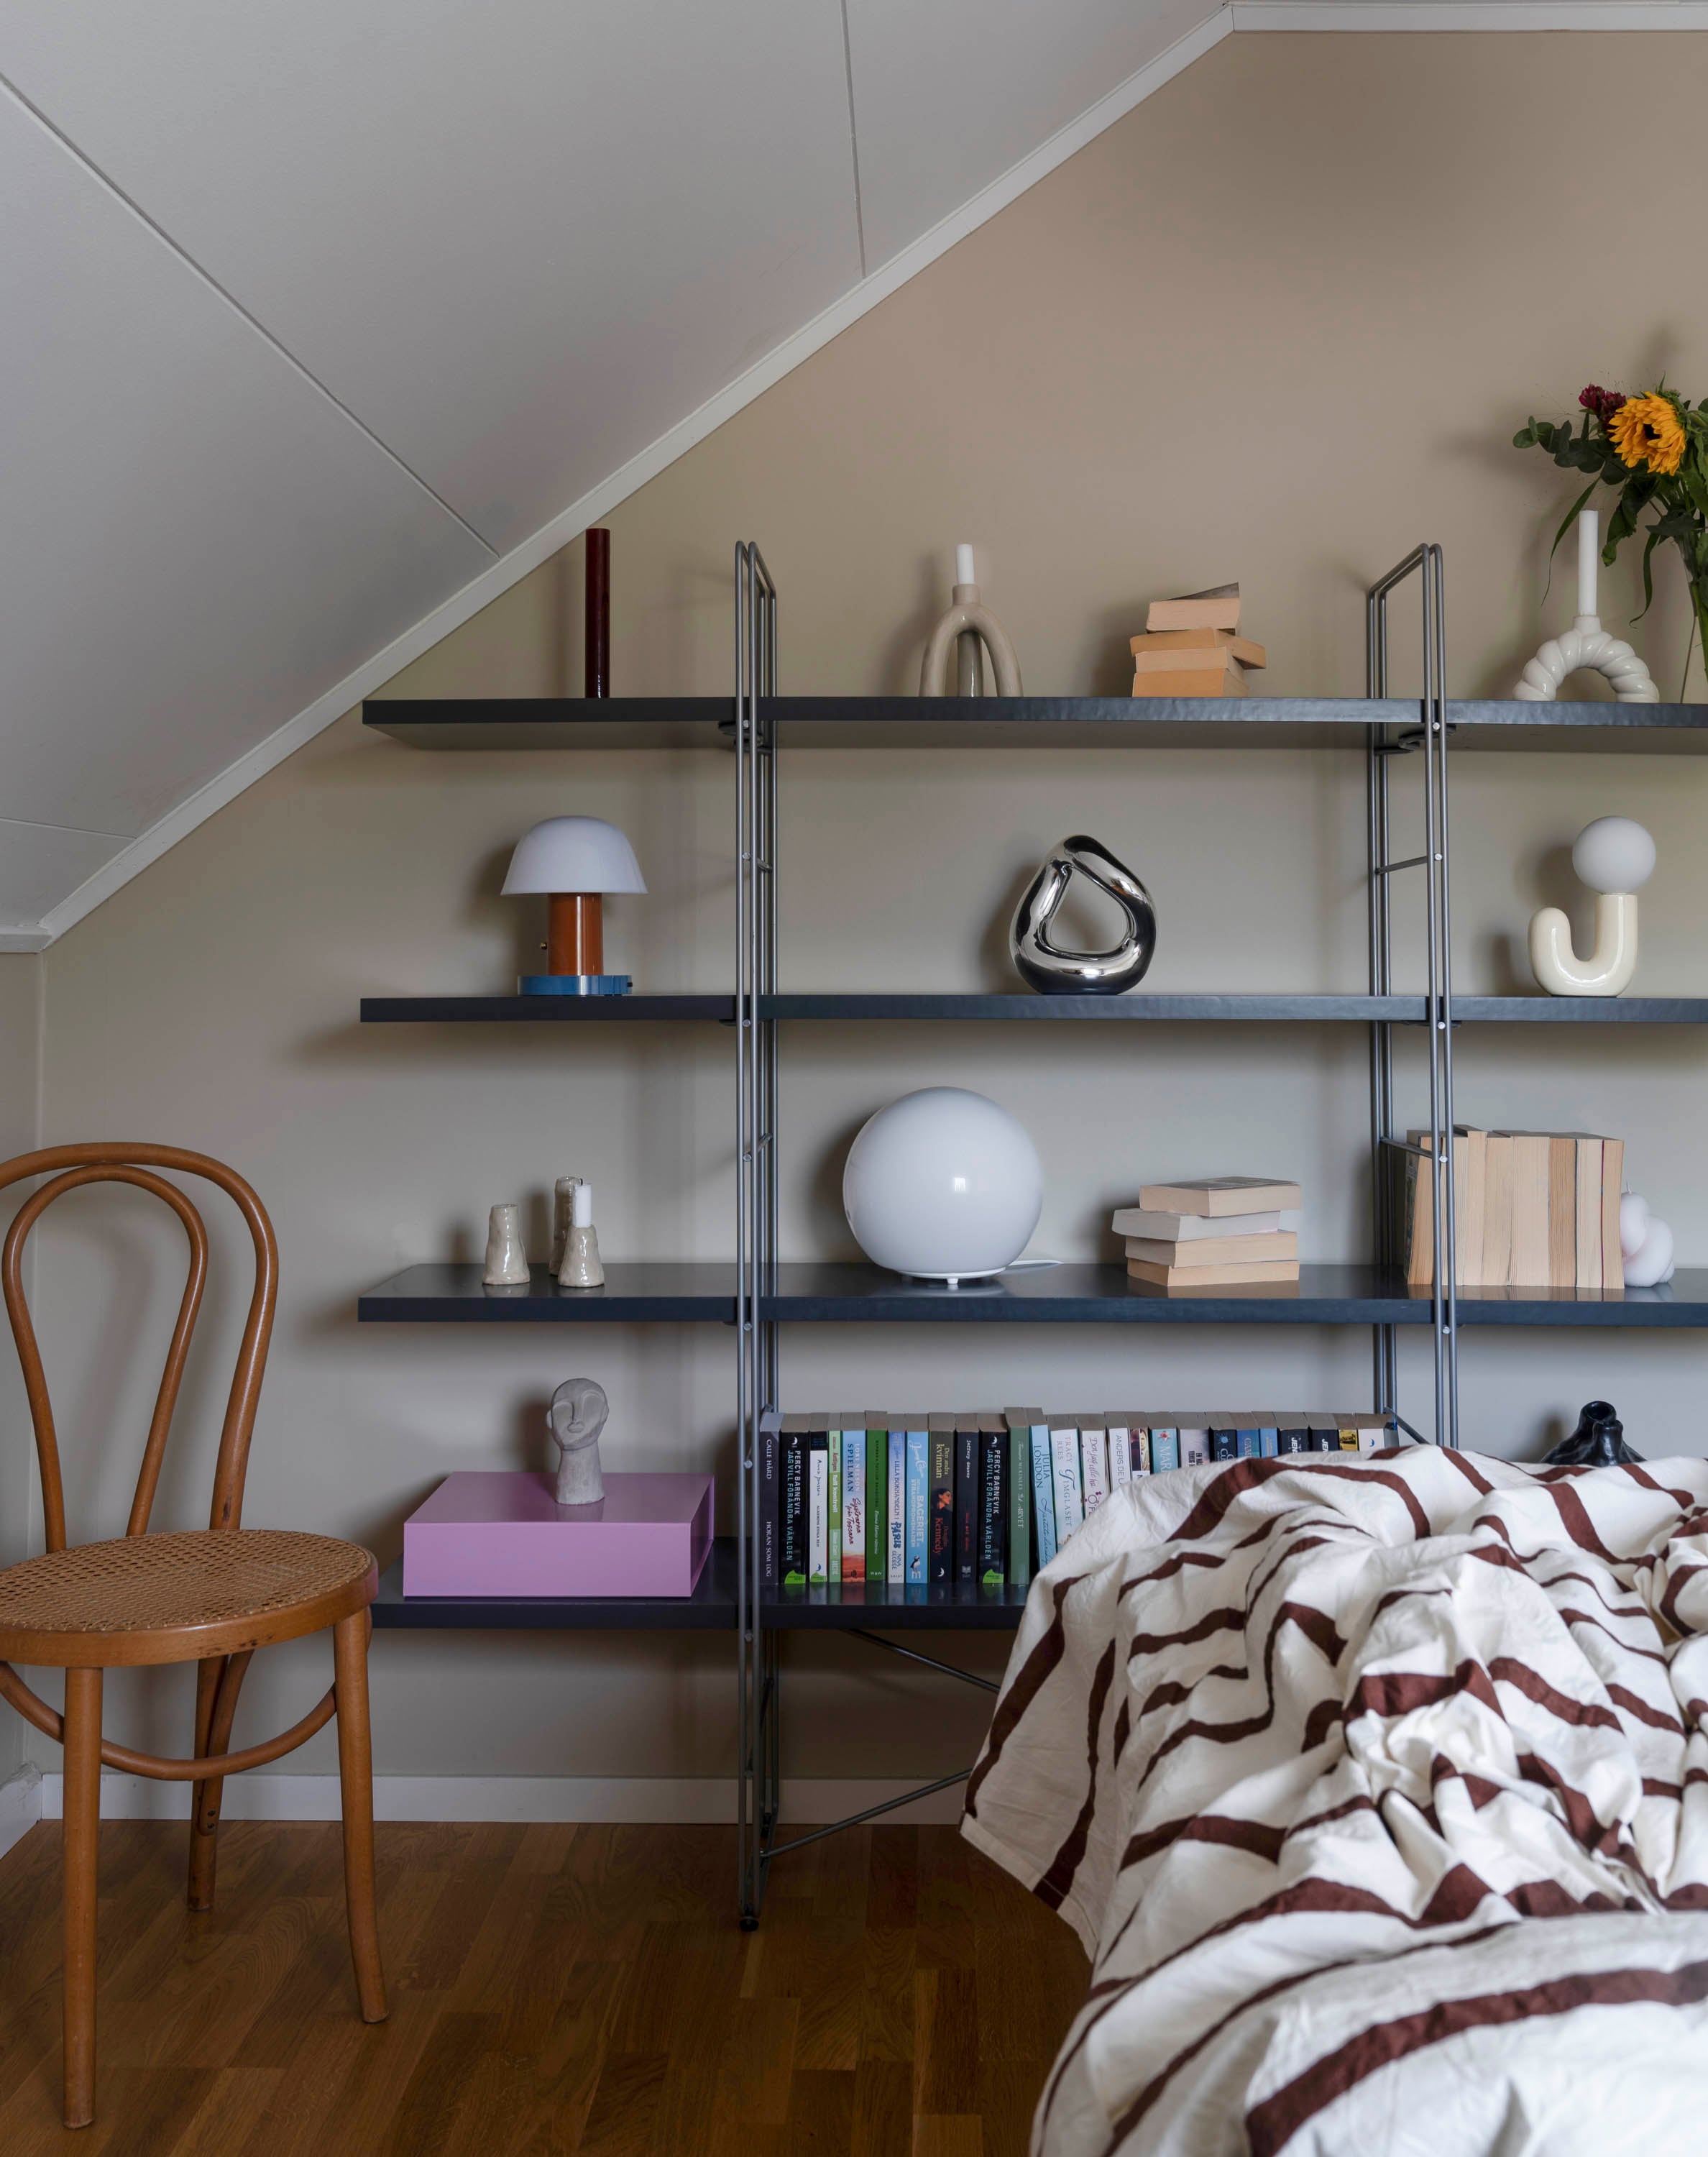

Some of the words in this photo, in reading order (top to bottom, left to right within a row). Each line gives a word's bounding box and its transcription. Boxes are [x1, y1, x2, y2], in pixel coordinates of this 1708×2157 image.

[1034, 1445, 1044, 1488] LONDON
[1040, 1454, 1050, 1479] JULIA
[1117, 1466, 1124, 1477] DE
[1160, 1446, 1172, 1473] MAR
[1058, 1469, 1076, 1528] TIMGLASET
[891, 1521, 902, 1549] PARIS
[932, 1518, 943, 1554] Kennedy
